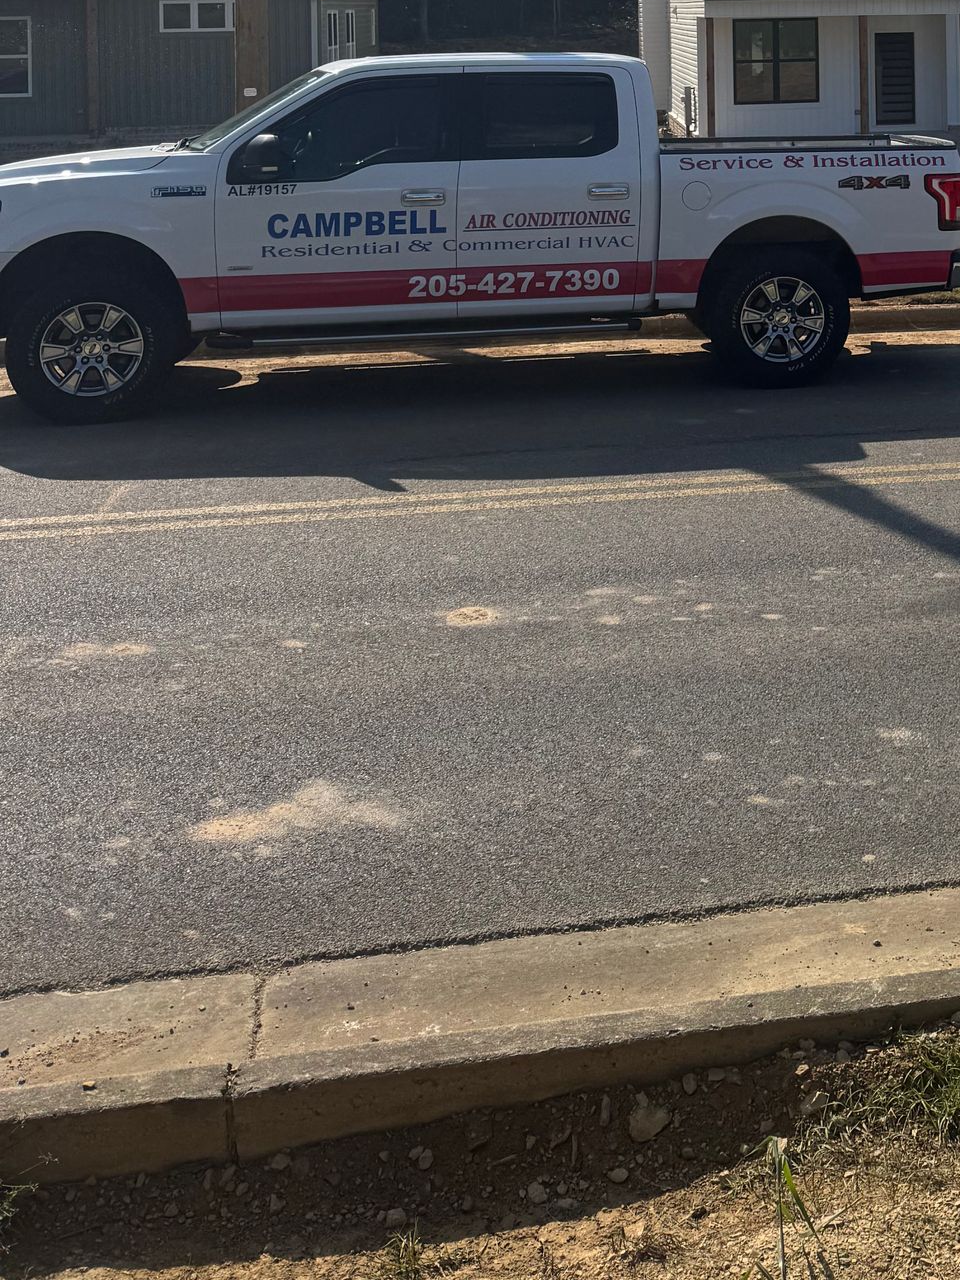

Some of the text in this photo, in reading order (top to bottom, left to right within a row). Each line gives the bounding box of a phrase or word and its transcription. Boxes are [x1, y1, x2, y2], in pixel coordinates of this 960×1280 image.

[679, 153, 946, 171] Service & Installation
[227, 183, 298, 197] AL#19157
[267, 209, 447, 240] CAMPBELL
[464, 210, 632, 230] AIR CONDITIONING
[262, 235, 635, 258] Residential & Commercial HVAC
[408, 268, 621, 299] 205-427-7390
